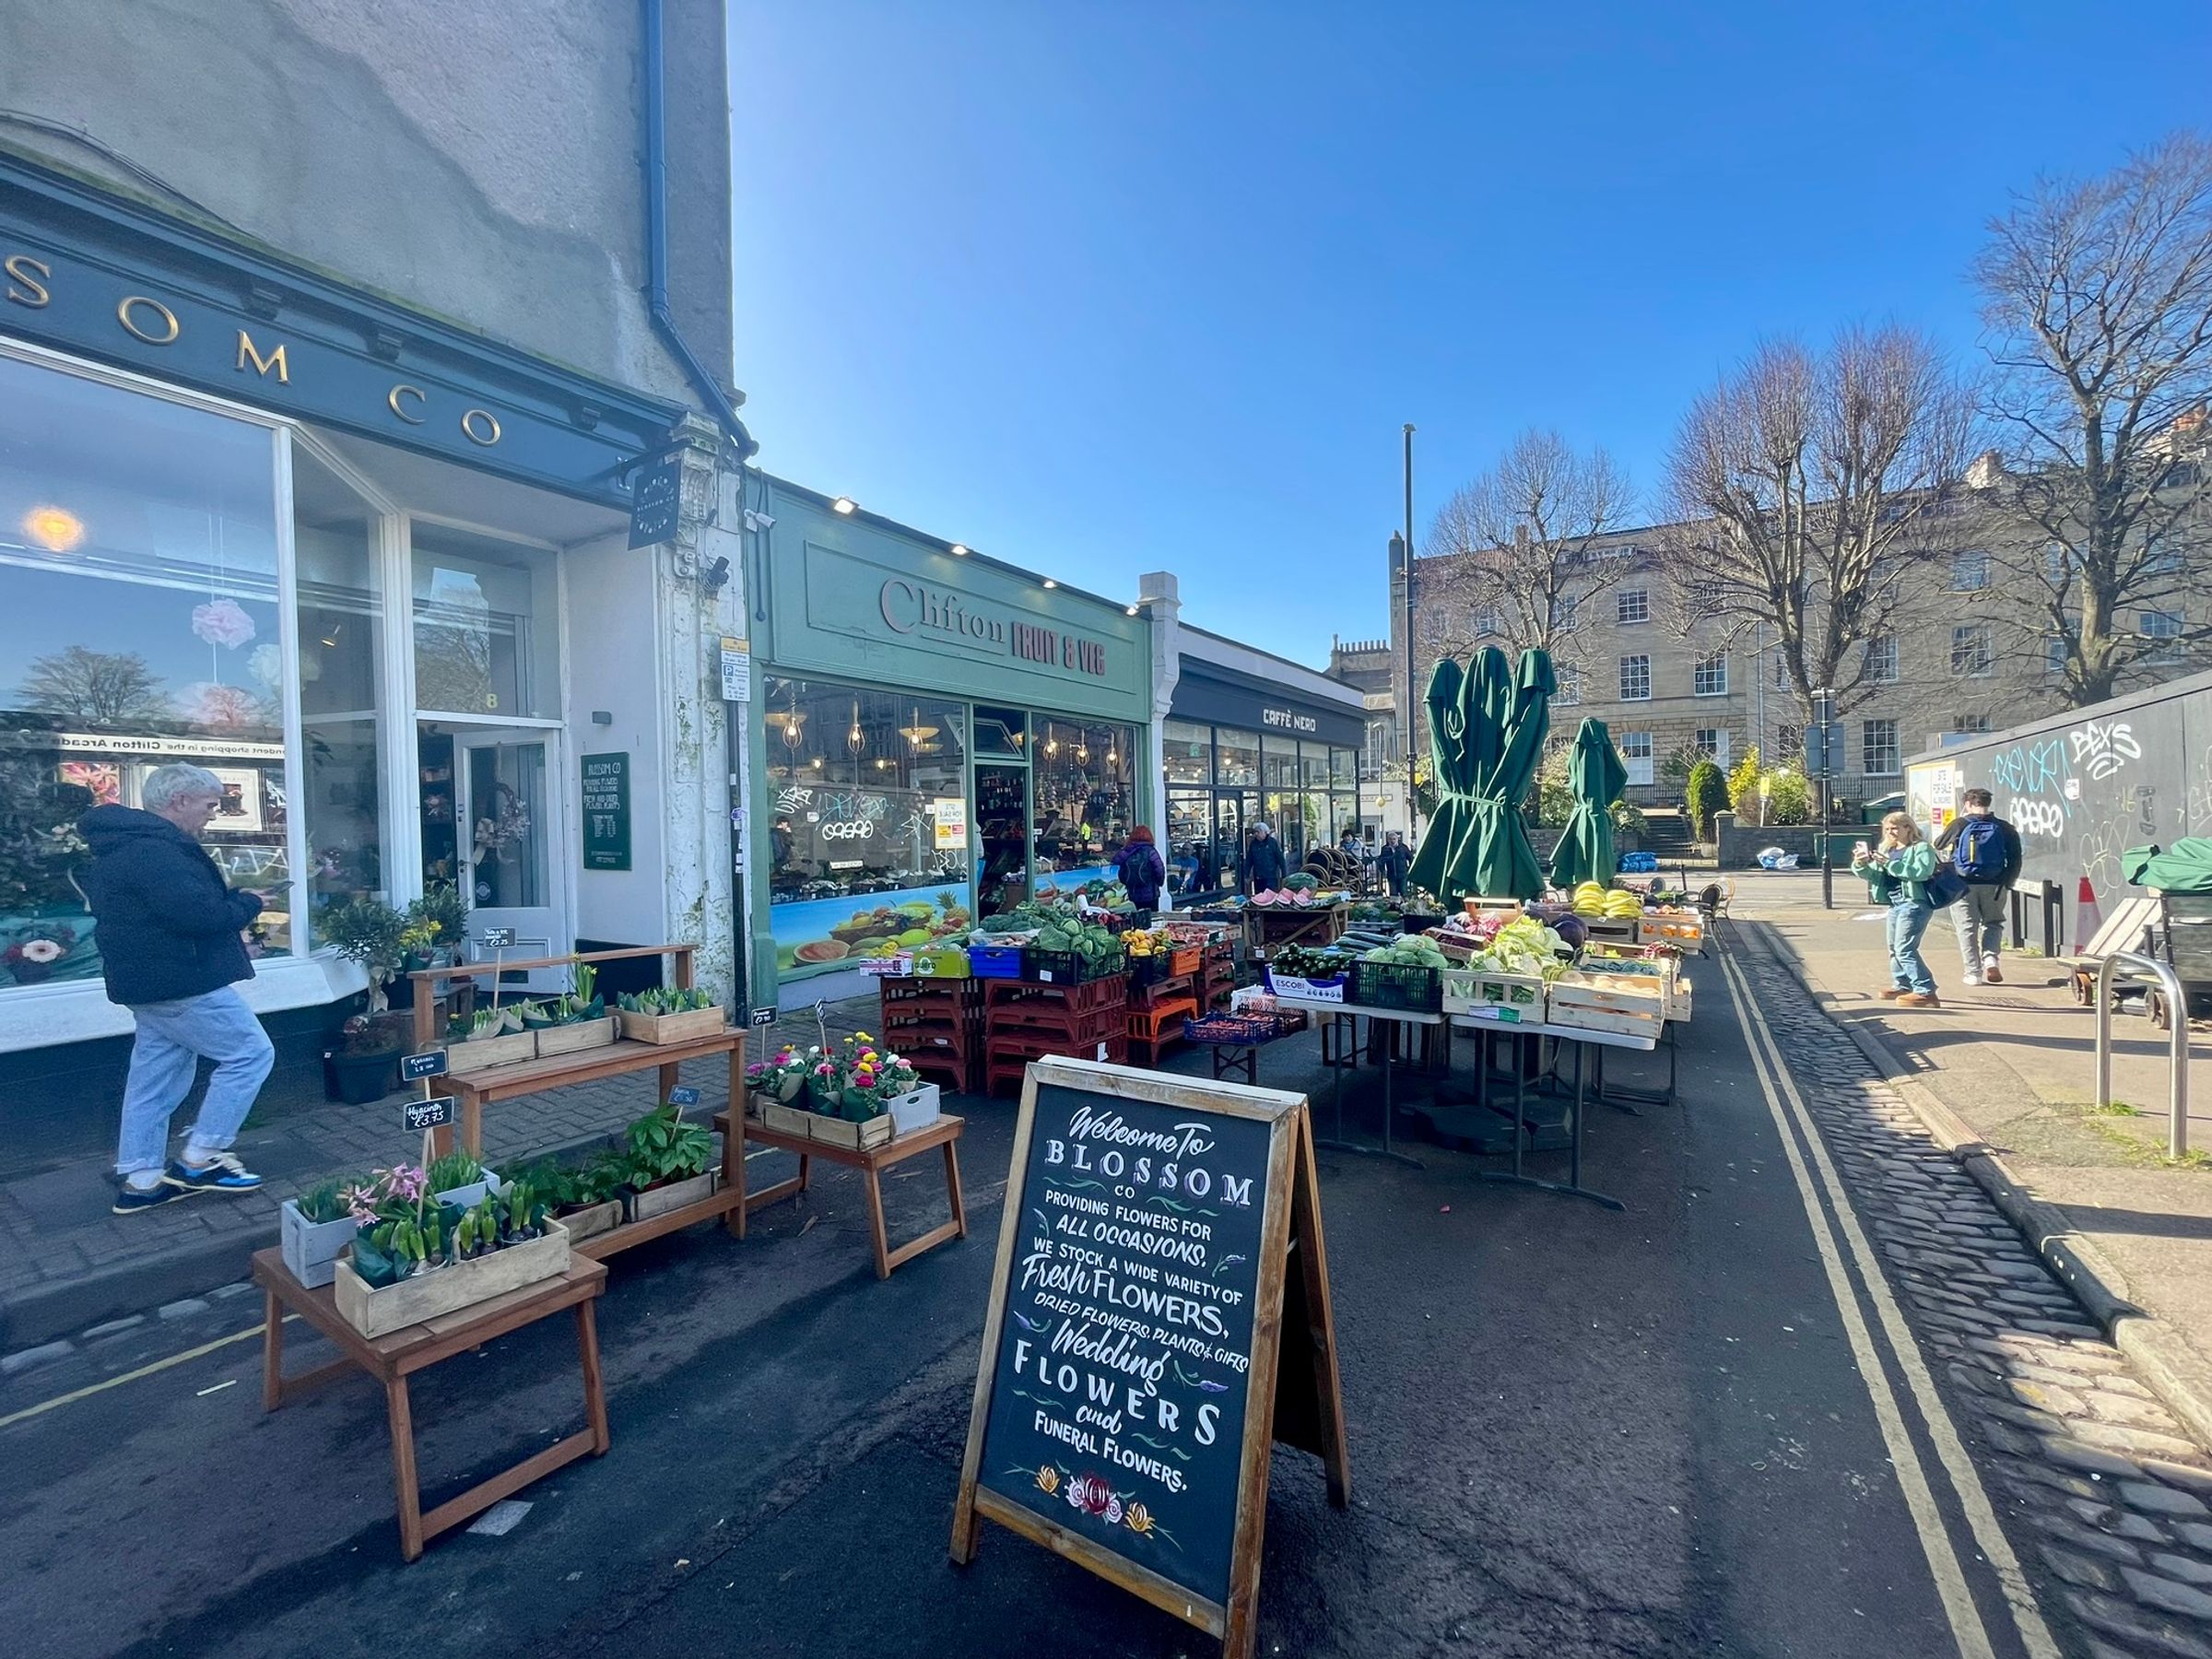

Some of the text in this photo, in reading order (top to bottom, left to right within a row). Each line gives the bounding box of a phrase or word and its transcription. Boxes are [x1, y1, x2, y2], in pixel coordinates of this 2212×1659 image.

[389, 384, 501, 446] CO
[879, 577, 1106, 676] Clifton FRUIT & VEG
[487, 693, 498, 709] 8
[1263, 709, 1316, 732] CAFFÈ NERO
[1277, 979, 1305, 989] ESCOBI
[407, 1103, 442, 1120] Hyacinth
[414, 1111, 444, 1127] £3.75
[1069, 1106, 1216, 1160] Welcome To
[1044, 1139, 1253, 1206] BLOSSOM
[1114, 1185, 1135, 1199] CO
[1045, 1190, 1211, 1241] PROVIDING FLOWERS FOR
[1056, 1214, 1088, 1238] ALL
[1021, 1253, 1229, 1339] Fresh FLOWERS,
[1033, 1237, 1243, 1305] WE STOCK A WIDE VARIETY OF
[1034, 1292, 1081, 1316] DRIED
[1152, 1328, 1205, 1358] PLANTS
[1214, 1347, 1249, 1373] GIFTS
[1051, 1319, 1171, 1396] Wedding
[1015, 1339, 1220, 1445] FLOWERS
[1076, 1405, 1122, 1435] and
[1034, 1410, 1188, 1493] FUNERAL FLOWERS.
